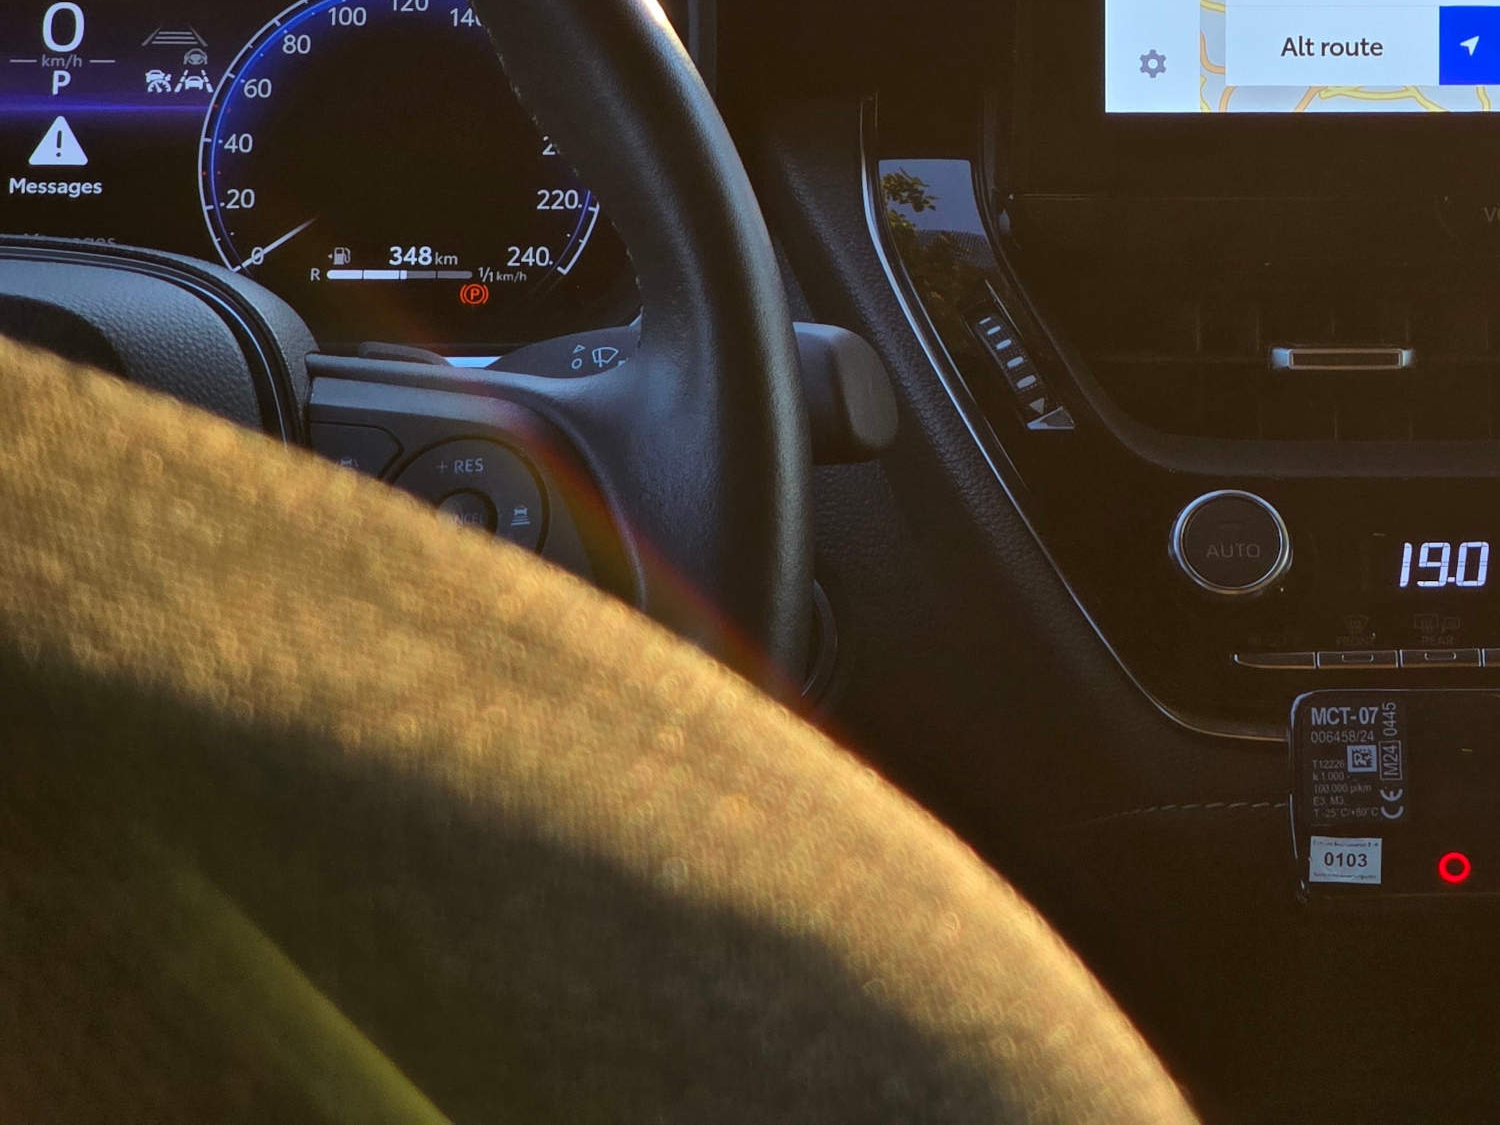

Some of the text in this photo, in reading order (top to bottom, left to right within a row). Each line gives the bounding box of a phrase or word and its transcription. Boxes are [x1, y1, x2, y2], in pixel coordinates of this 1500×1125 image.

[42, 1, 85, 53] 0
[328, 7, 367, 27] 100
[283, 34, 311, 54] 80
[1281, 37, 1384, 58] Alt route
[42, 54, 82, 69] km/h
[52, 72, 70, 95] P
[243, 79, 272, 98] 60
[224, 134, 253, 153] 40
[9, 179, 102, 198] Messages
[227, 189, 255, 209] 20
[537, 189, 578, 210] 220
[389, 246, 458, 266] 348 km
[507, 247, 549, 266] 240
[310, 268, 321, 281] R
[1206, 543, 1261, 559] AUTO
[1400, 541, 1490, 588] 19.0
[1311, 707, 1379, 726] MCT-07
[1383, 744, 1399, 776] M24
[1324, 852, 1367, 868] 0103
